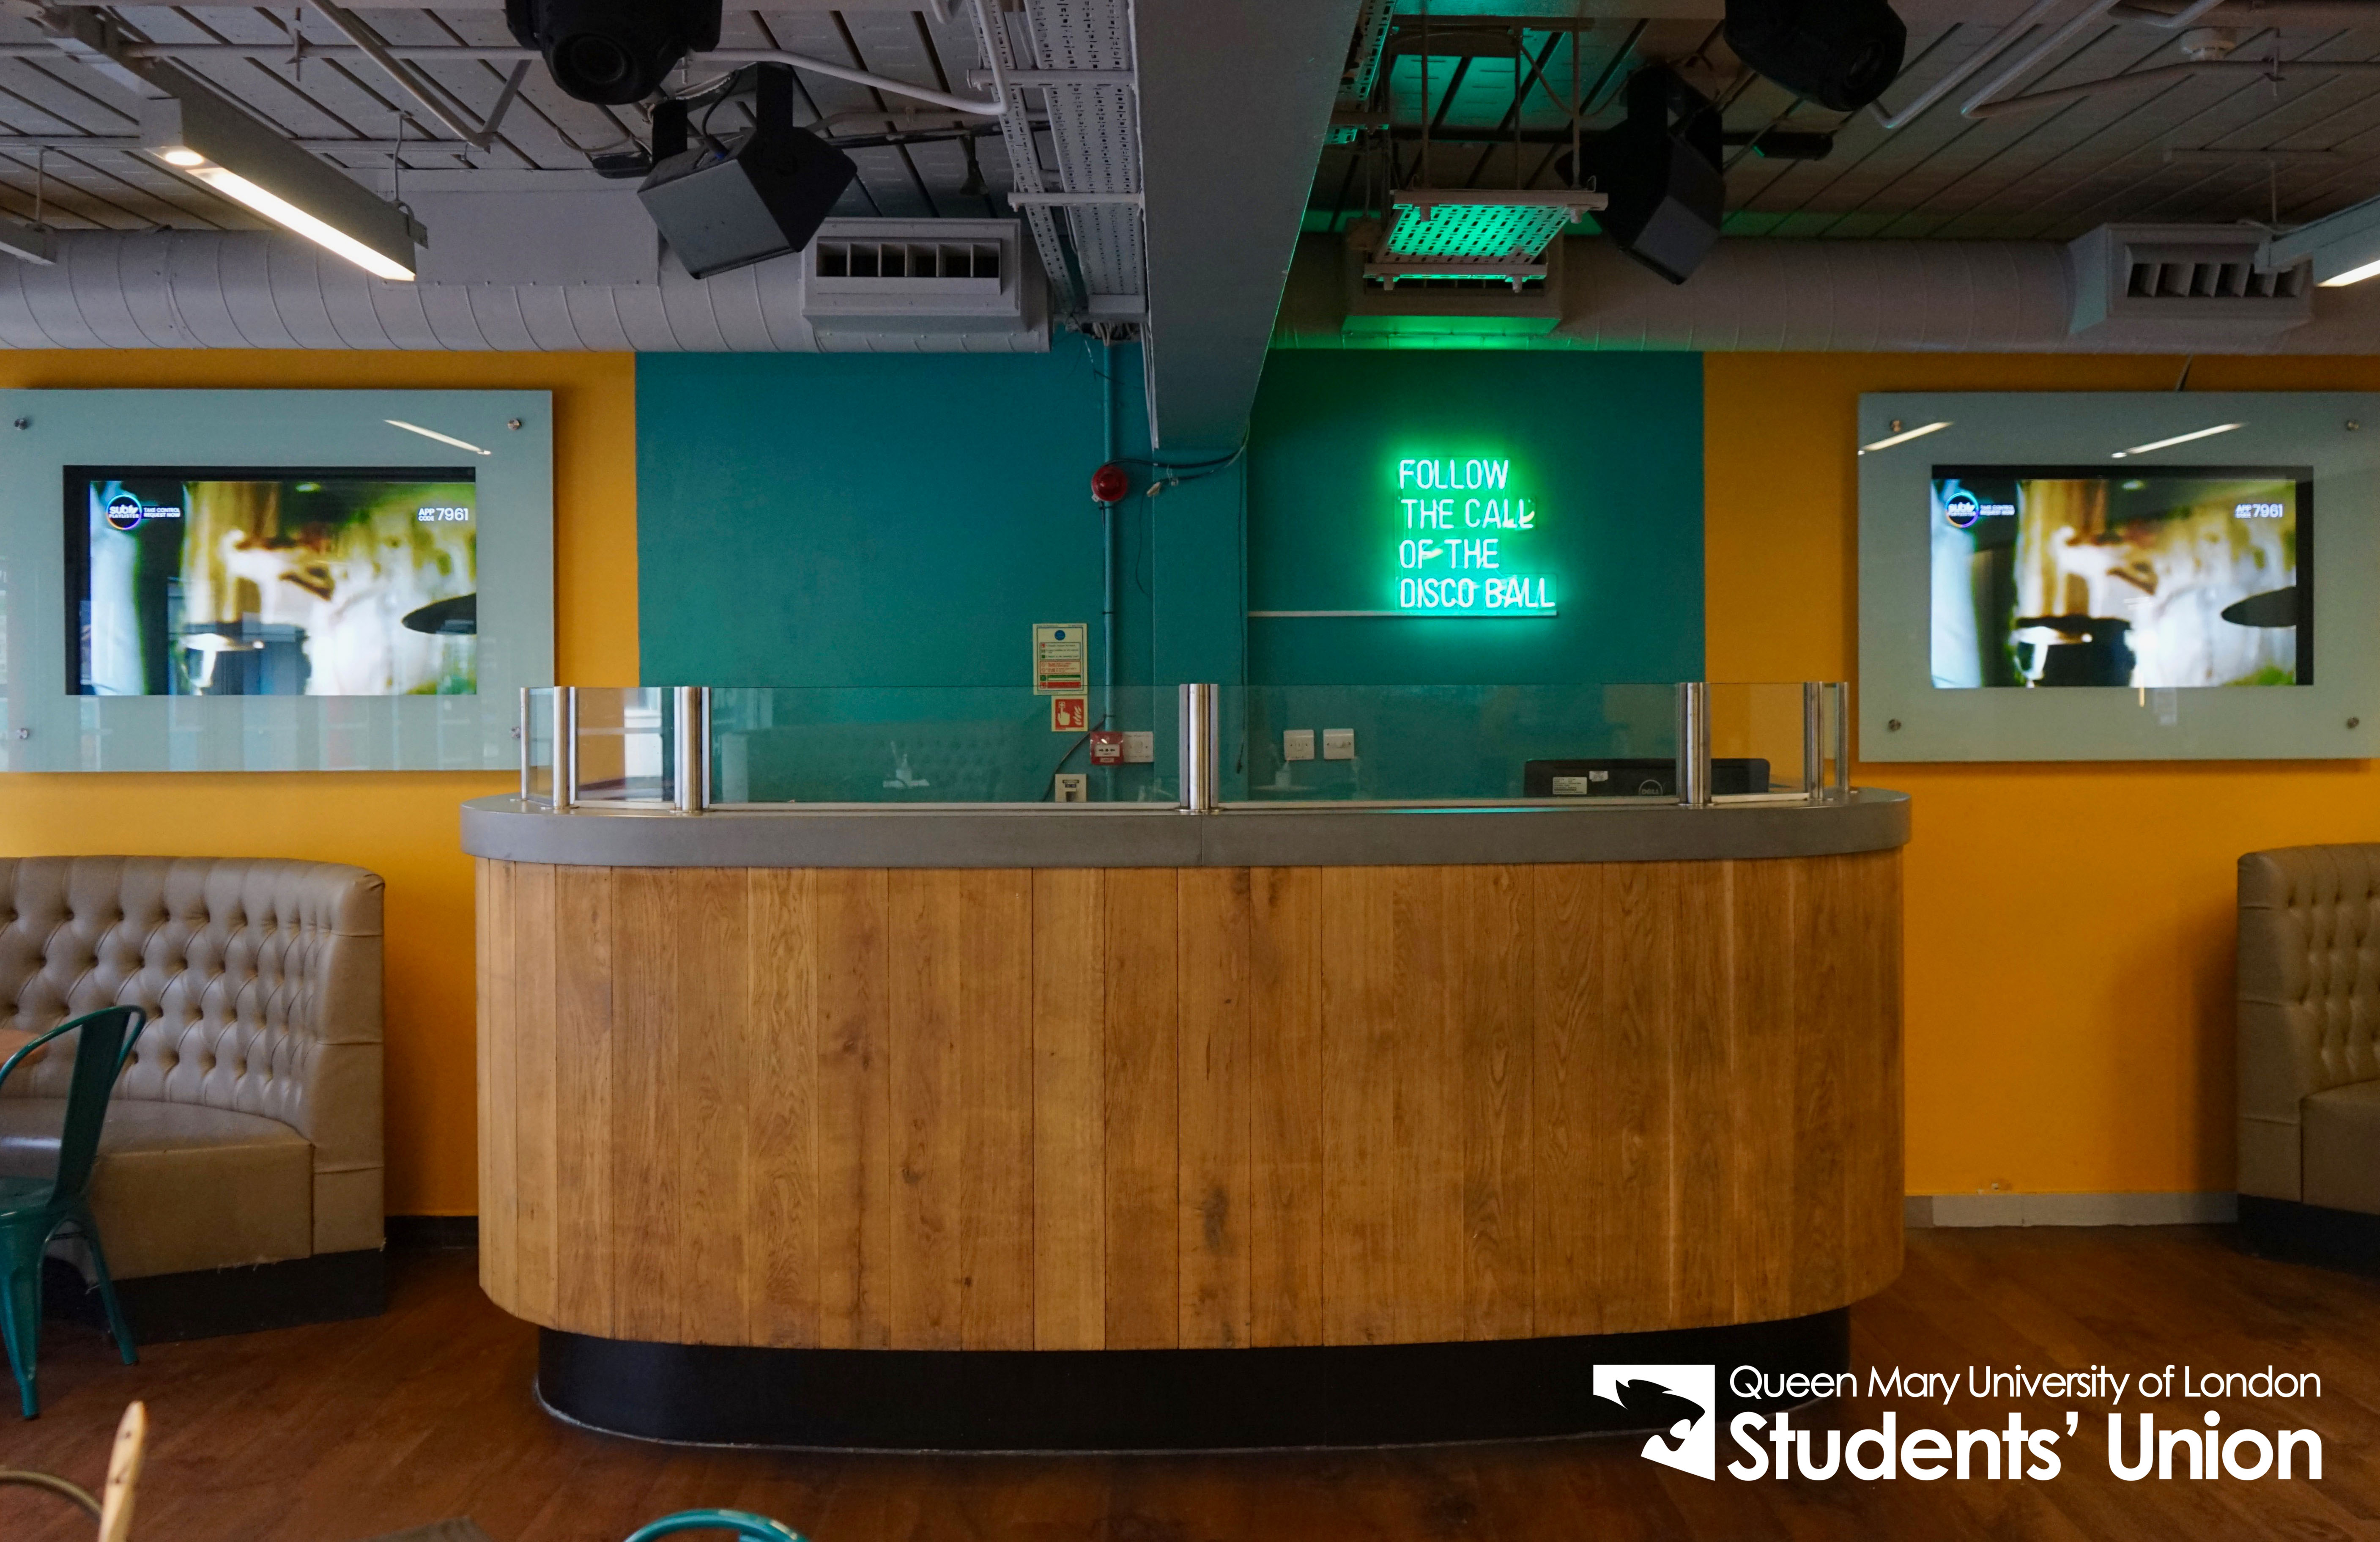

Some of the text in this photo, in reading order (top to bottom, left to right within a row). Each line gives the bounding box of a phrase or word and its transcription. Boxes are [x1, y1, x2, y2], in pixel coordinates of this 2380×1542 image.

[1400, 459, 1509, 489] FOLLOW
[436, 508, 468, 521] 7961
[1401, 499, 1535, 529] THE CALL
[2252, 504, 2283, 518] 7961
[1400, 538, 1499, 569] OF THE
[1400, 578, 1556, 608] DISCO BALL
